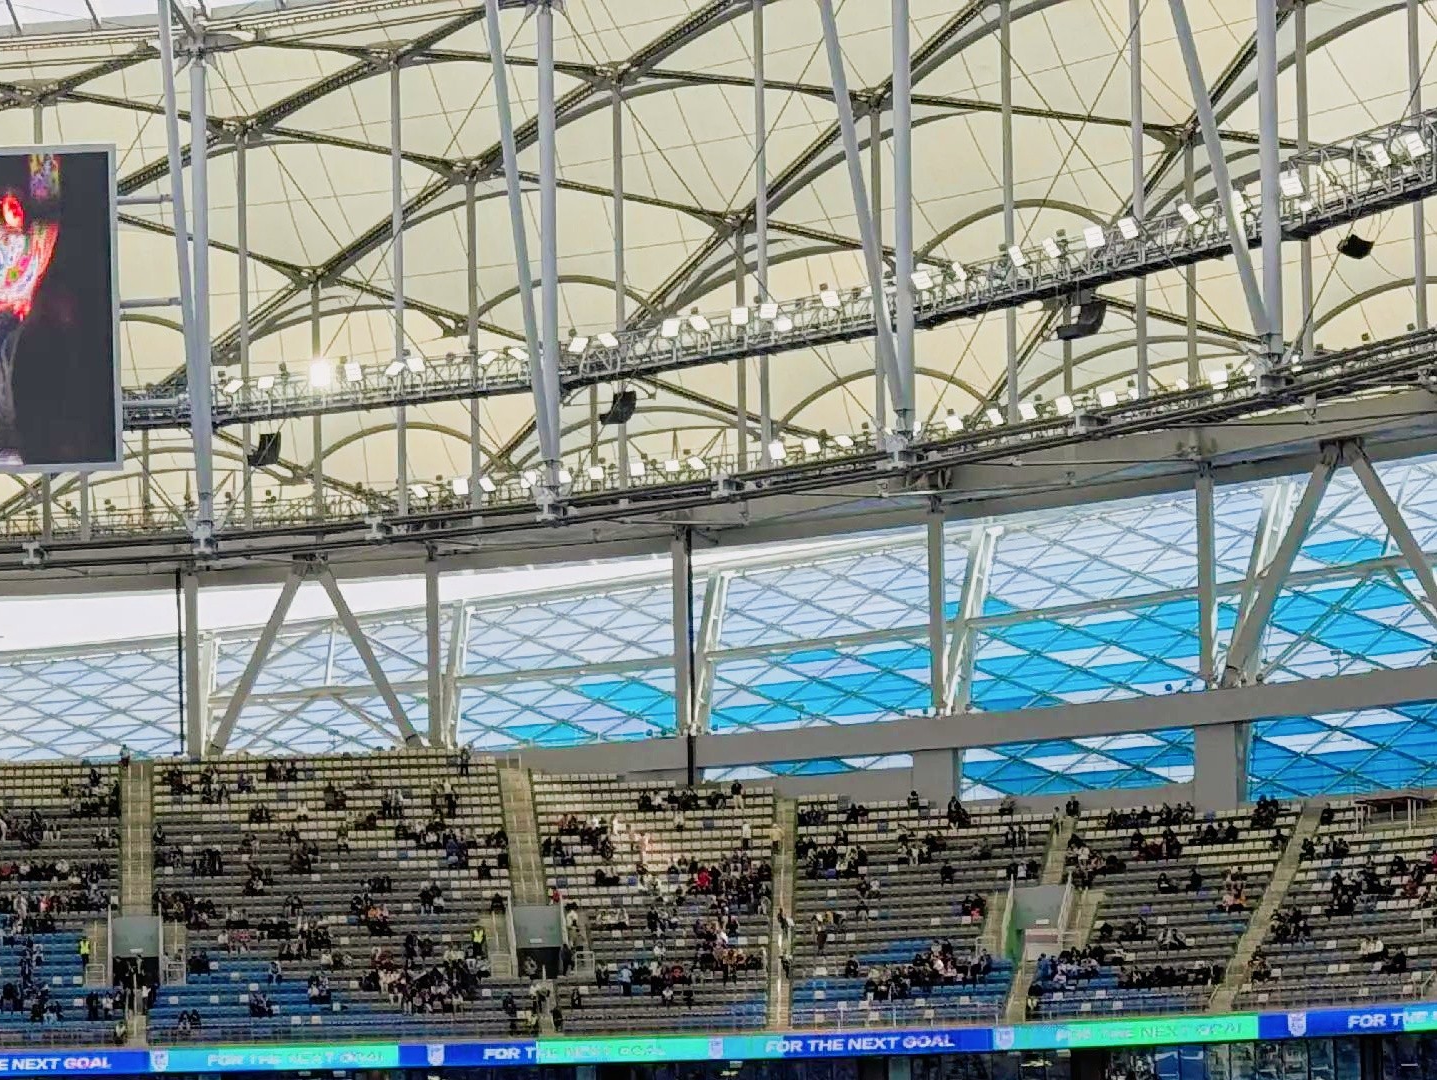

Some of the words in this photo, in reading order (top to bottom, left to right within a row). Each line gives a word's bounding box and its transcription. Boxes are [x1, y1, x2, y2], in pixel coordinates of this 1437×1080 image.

[1348, 1015, 1386, 1028] FOR
[1391, 1012, 1429, 1026] THE
[766, 1040, 802, 1053] FOR
[808, 1038, 843, 1052] THE
[848, 1037, 899, 1051] NEXT
[903, 1035, 955, 1048] GOAL
[207, 1054, 242, 1066] FOR
[483, 1048, 520, 1060] FOR
[12, 1058, 59, 1070] NEXT
[64, 1057, 112, 1069] GOAL
